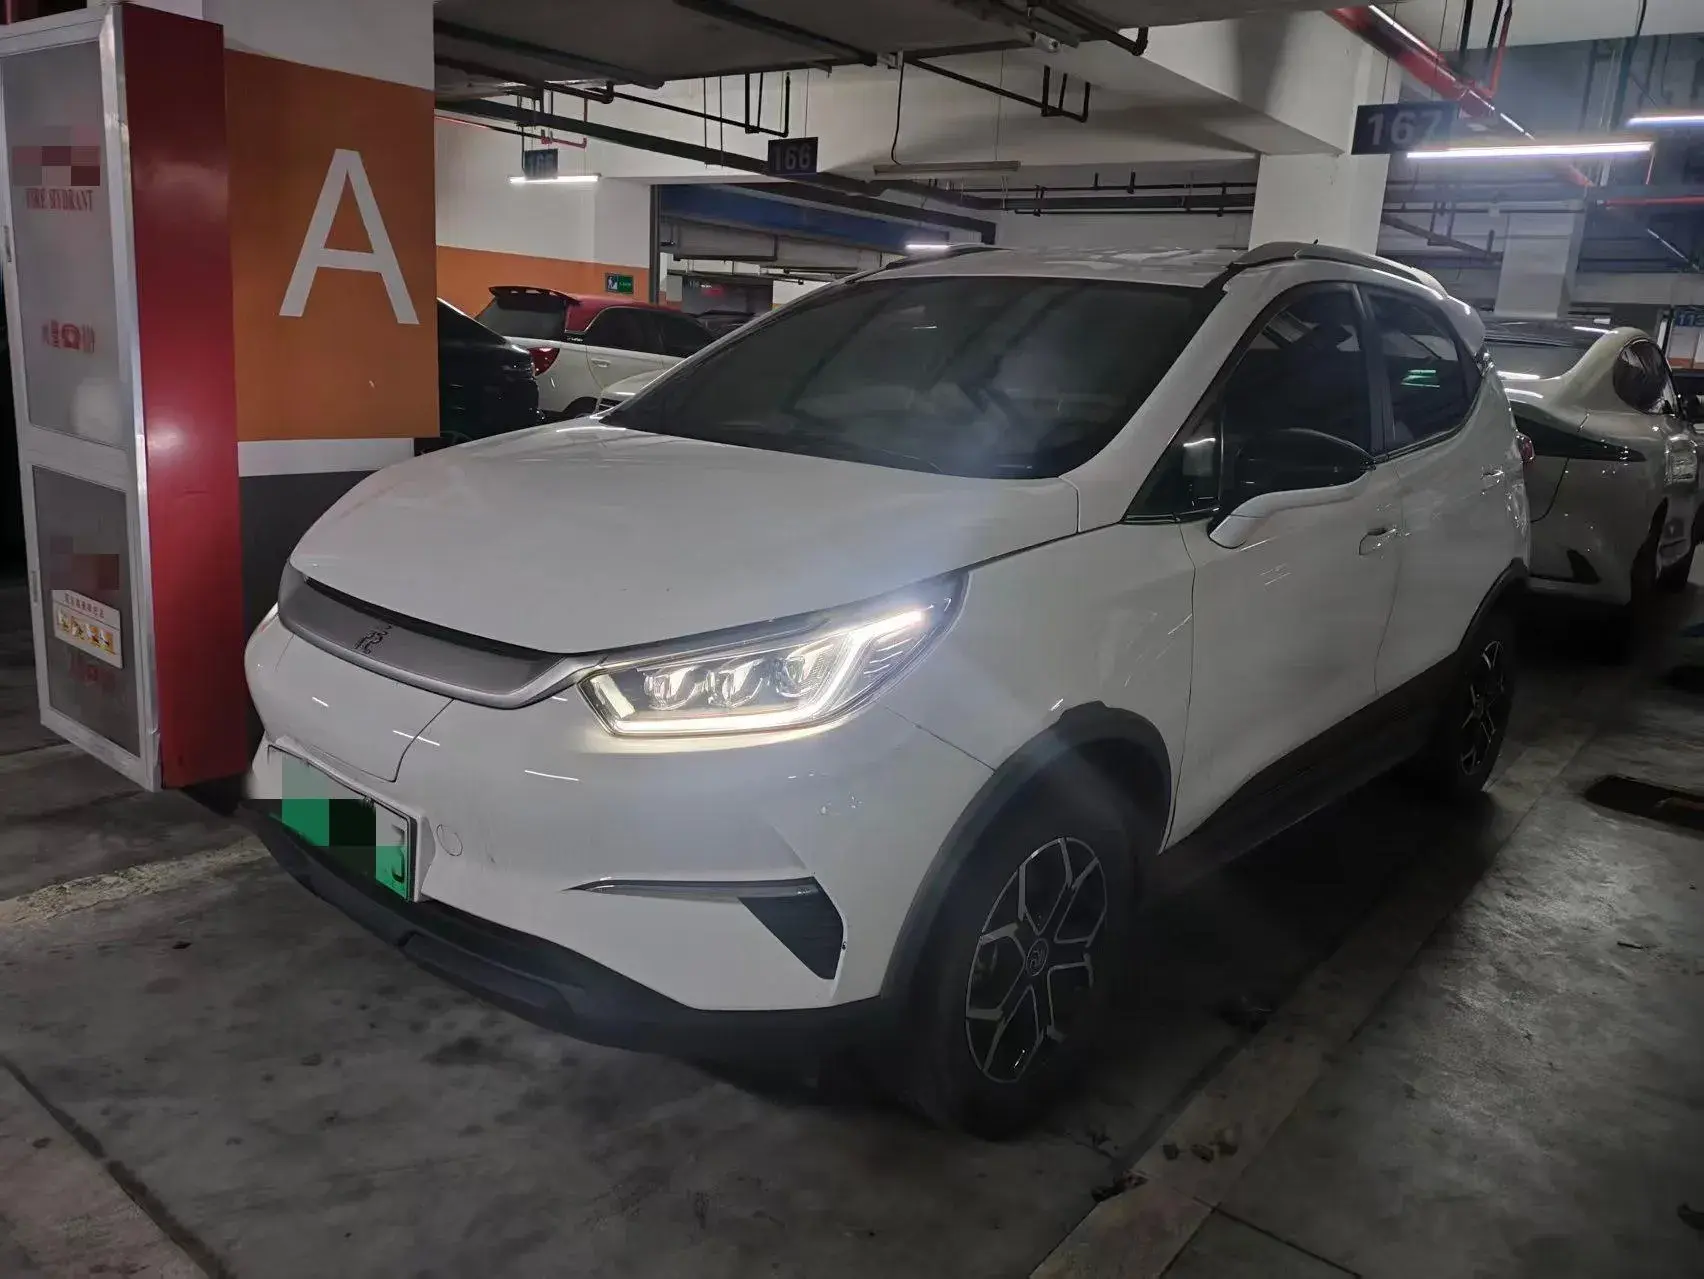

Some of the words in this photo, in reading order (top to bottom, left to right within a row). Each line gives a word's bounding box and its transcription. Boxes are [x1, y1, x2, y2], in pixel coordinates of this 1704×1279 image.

[1367, 109, 1443, 147] 167
[772, 143, 812, 172] 166
[279, 148, 420, 325] A
